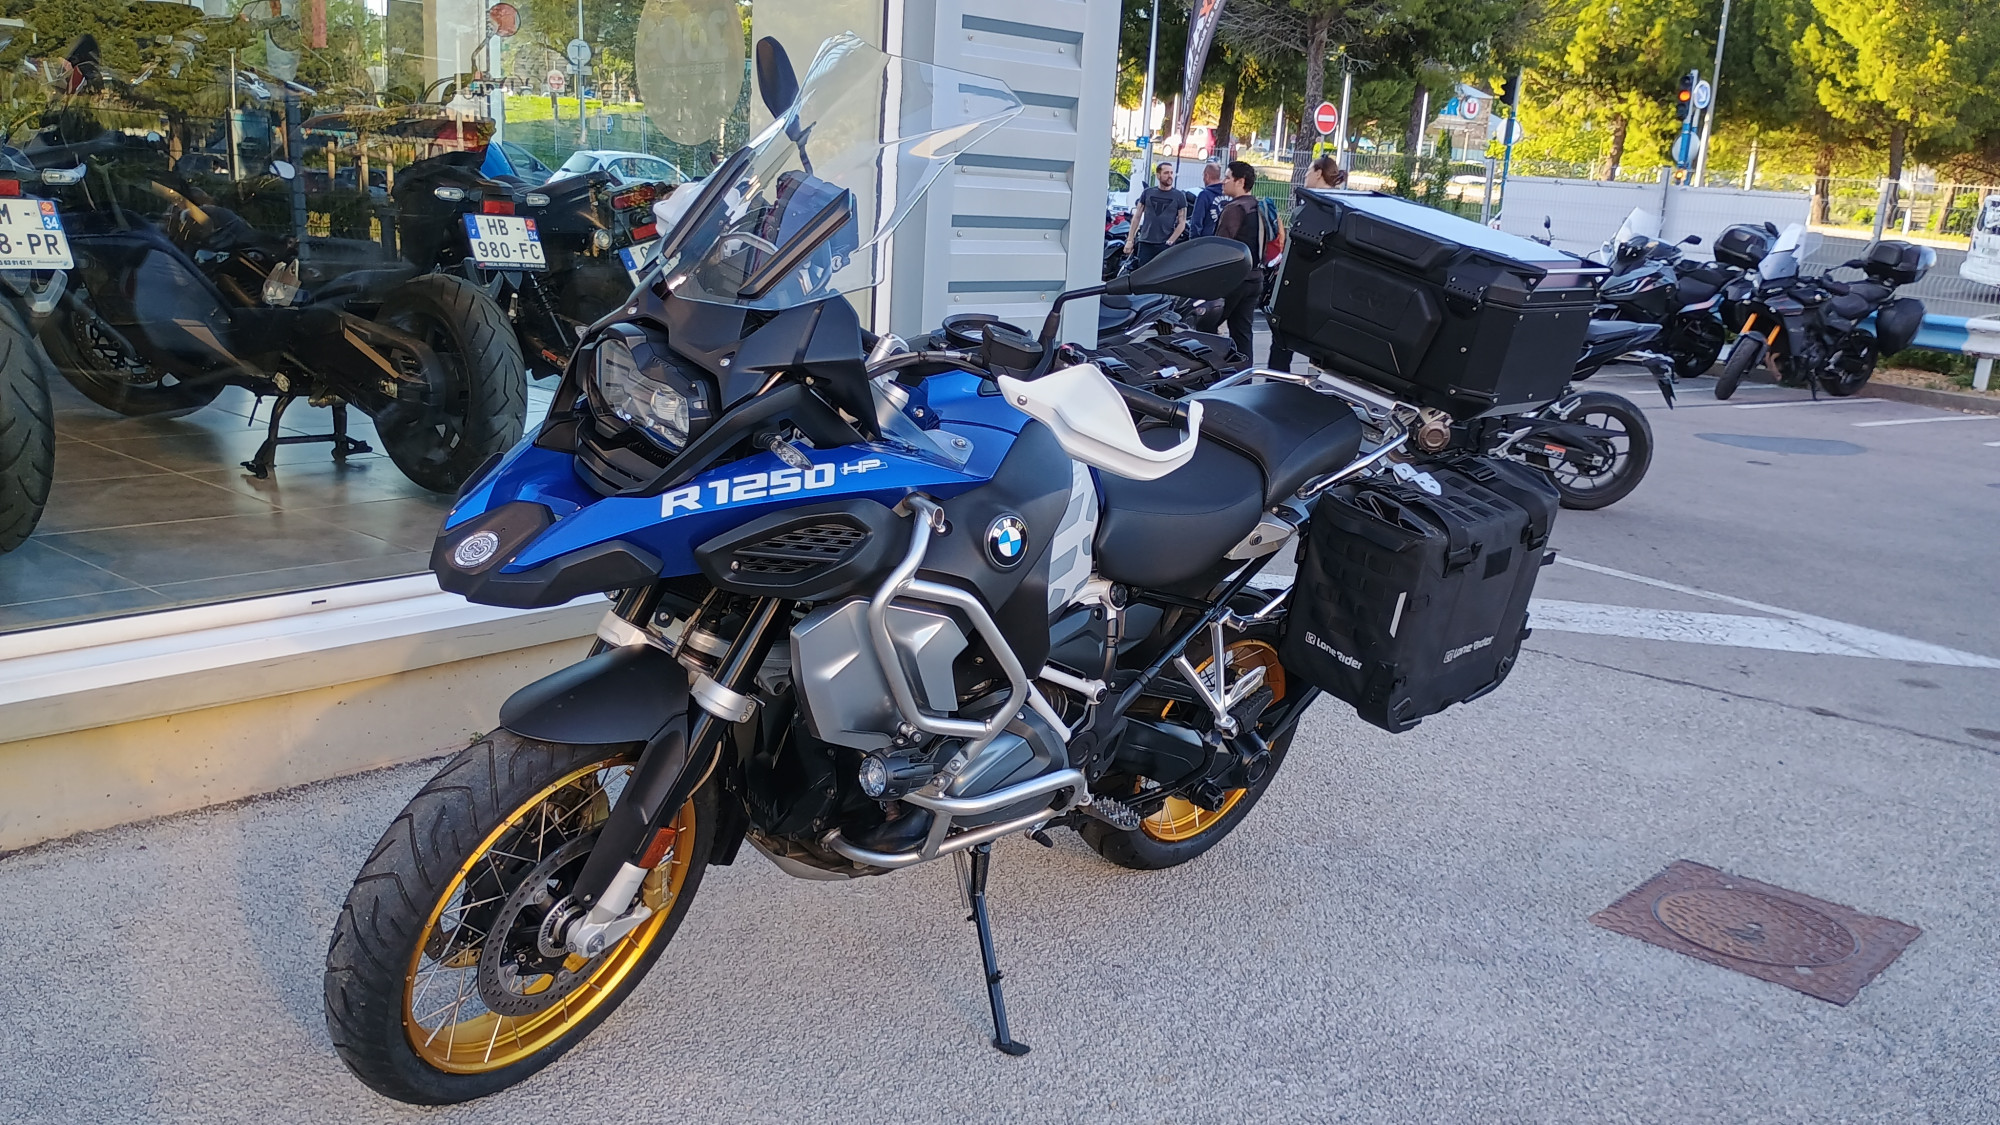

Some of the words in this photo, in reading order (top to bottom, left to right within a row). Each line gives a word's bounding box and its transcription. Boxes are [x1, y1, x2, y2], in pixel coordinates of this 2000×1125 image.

[43, 216, 60, 230] 34
[486, 218, 509, 236] HB
[528, 230, 539, 241] 34
[478, 241, 541, 260] 980-FC
[661, 485, 703, 518] R
[708, 462, 836, 505] 1250
[840, 459, 886, 475] HP
[992, 518, 1023, 538] BMW
